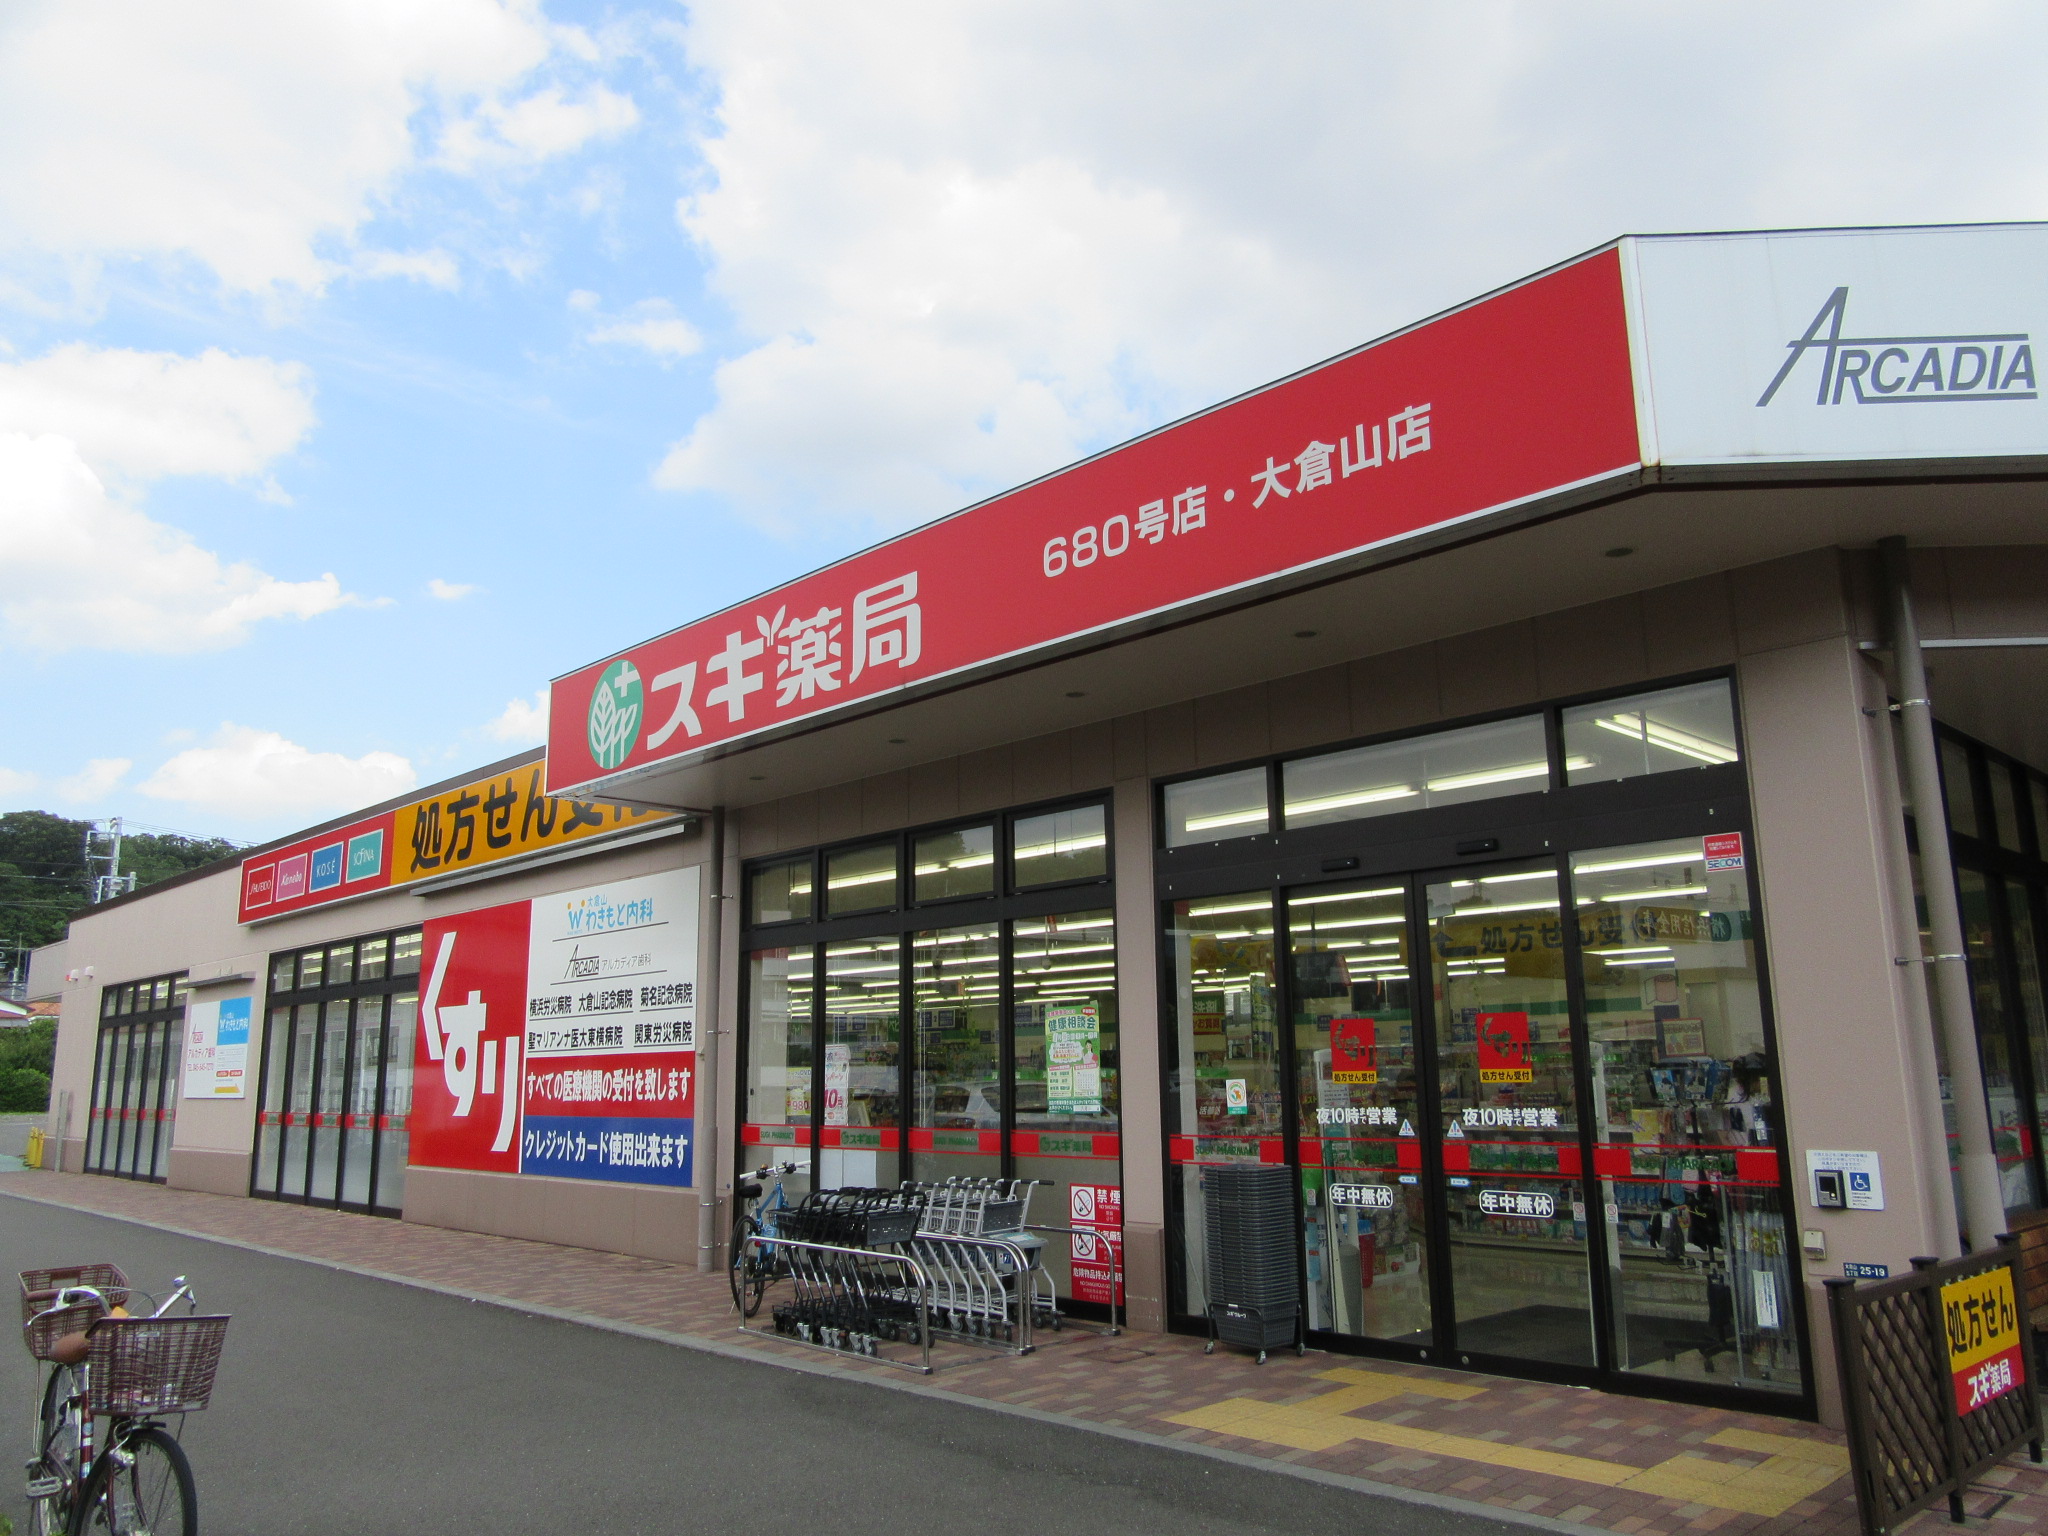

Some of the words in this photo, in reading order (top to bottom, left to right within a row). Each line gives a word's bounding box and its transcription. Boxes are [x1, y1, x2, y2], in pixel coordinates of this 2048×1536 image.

[1755, 286, 2038, 407] ARCADIA
[647, 571, 922, 750] スギ薬局
[353, 848, 375, 866] SOFINA
[1707, 857, 1742, 869] SECOM
[281, 870, 303, 886] Kanebo
[586, 897, 654, 931] わきもと内科
[564, 944, 600, 979] ARCADIA
[529, 995, 572, 1018] 横浜労災病院
[578, 989, 634, 1013] 大倉山記念病院
[640, 982, 693, 1011] 菊名記念病院
[1048, 1016, 1096, 1032] 健康相談会
[422, 931, 520, 1152] くすり
[528, 1025, 623, 1050] 聖マリアンナ医大東横病院
[634, 1021, 693, 1044] 関東労災病院
[527, 1067, 691, 1102] すべての医療機関の受付を致します
[1334, 1072, 1375, 1082] 処方せん受付
[1482, 1070, 1530, 1081] 処方せん受付
[1316, 1107, 1398, 1125] 夜10時まで営業
[1462, 1107, 1558, 1127] 夜10時まで営業
[524, 1129, 689, 1169] クレジットカード使用出来ます
[1050, 1137, 1093, 1153] スギ薬局
[1096, 1188, 1121, 1205] 禁煙
[1332, 1186, 1392, 1205] 年中無休
[1481, 1193, 1551, 1215] 年中無休
[1860, 1266, 1885, 1277] 25-19
[1948, 1286, 2013, 1357] 処方せん
[1968, 1358, 2011, 1407] スギ薬局
